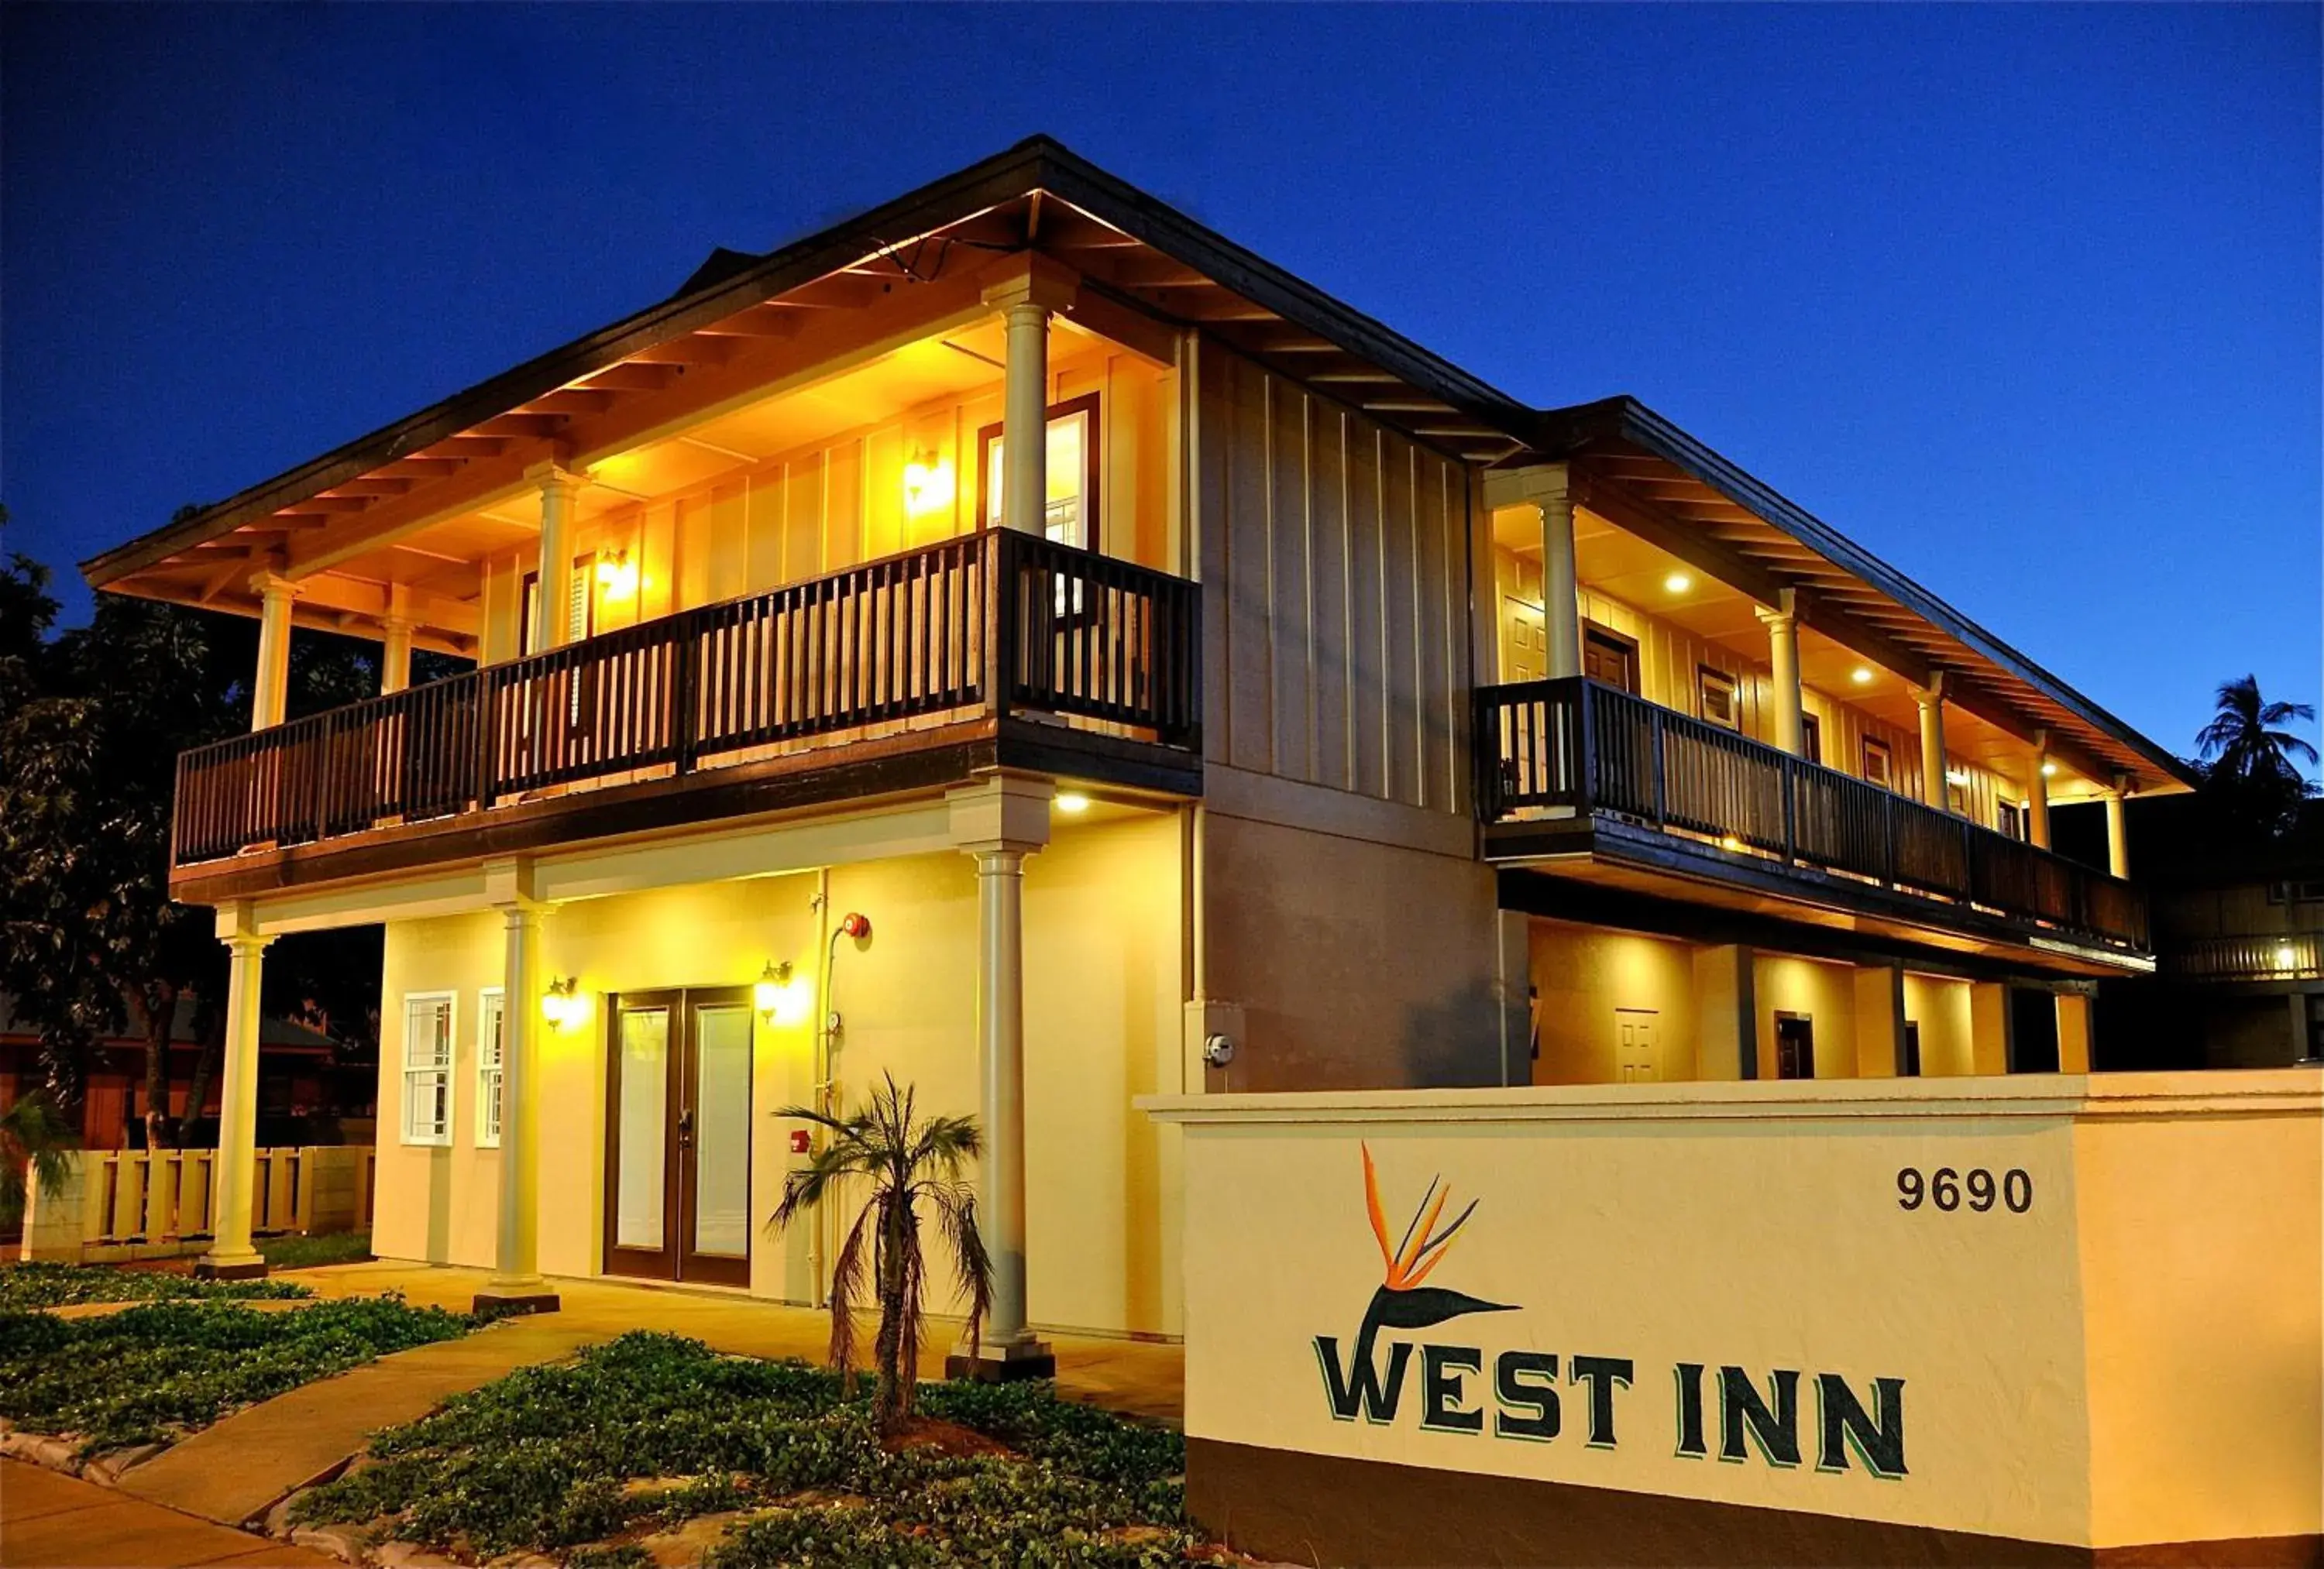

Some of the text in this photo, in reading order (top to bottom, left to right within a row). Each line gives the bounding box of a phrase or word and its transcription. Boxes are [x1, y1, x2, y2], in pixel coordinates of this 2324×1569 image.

[1897, 1167, 2033, 1214] 9690
[1313, 1336, 1909, 1480] WEST INN
